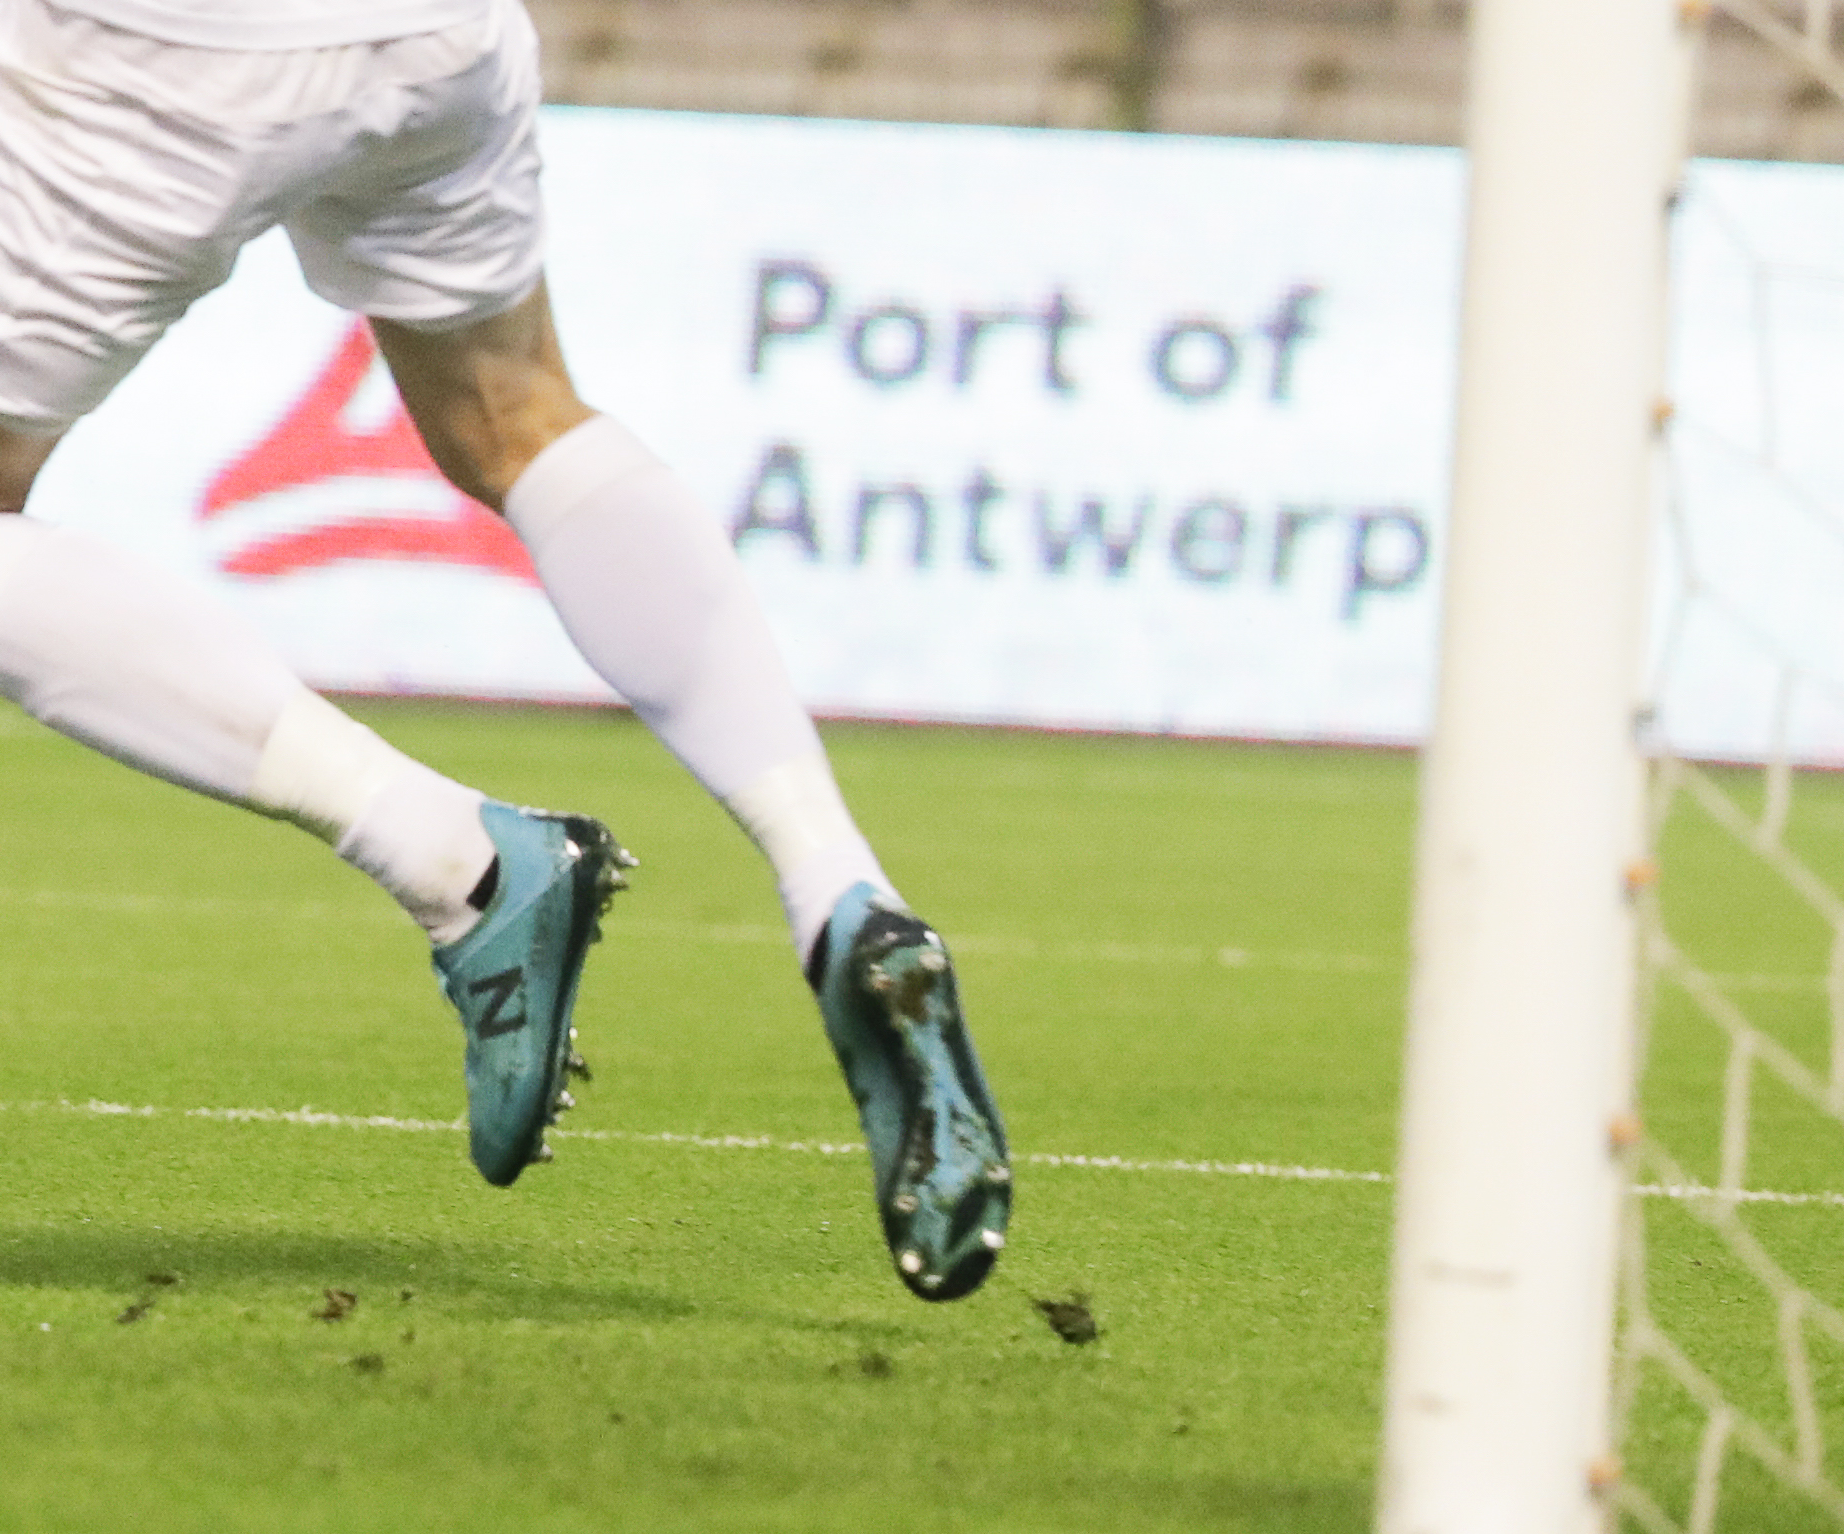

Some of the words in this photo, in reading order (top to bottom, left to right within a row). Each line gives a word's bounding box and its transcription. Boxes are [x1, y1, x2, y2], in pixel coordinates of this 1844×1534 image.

[746, 258, 1090, 396] Port
[1150, 280, 1322, 402] of
[731, 442, 1432, 623] Antwerp
